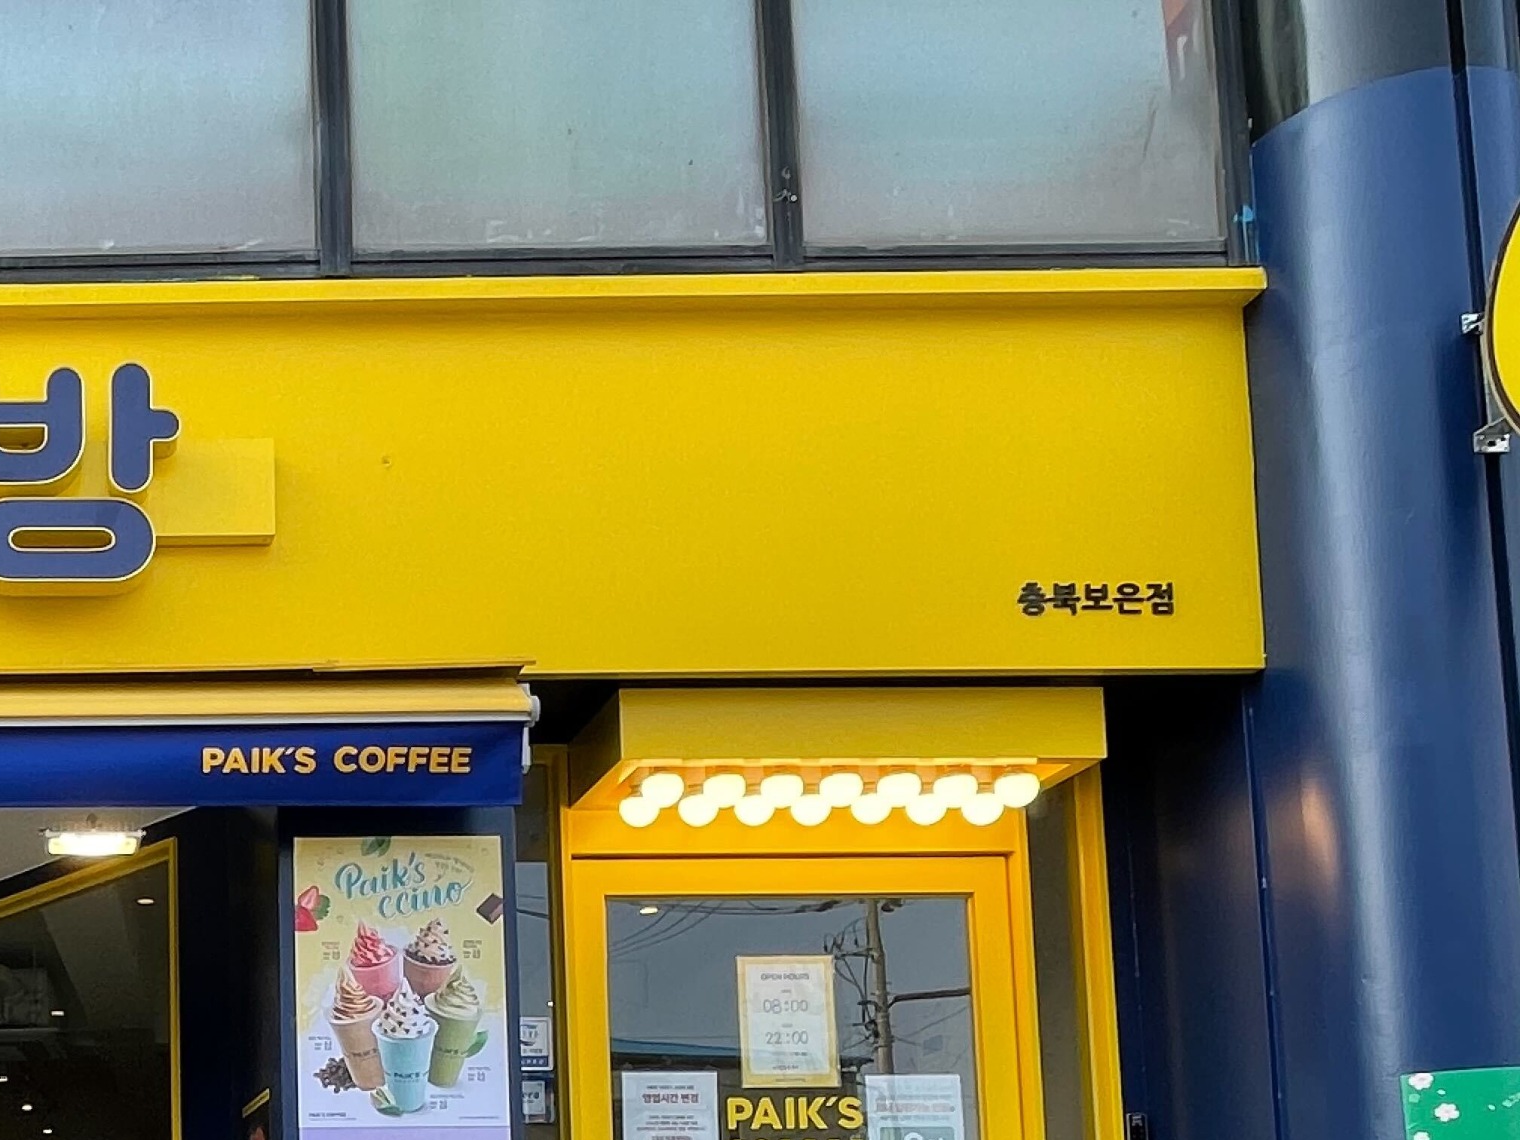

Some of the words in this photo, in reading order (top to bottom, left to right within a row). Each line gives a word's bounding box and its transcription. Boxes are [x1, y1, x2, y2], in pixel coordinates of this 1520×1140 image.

[1017, 582, 1174, 616] 충북보은점
[202, 747, 317, 774] PAIK'S
[334, 746, 472, 773] COFFEE
[334, 852, 426, 899] Paik's
[379, 878, 473, 919] ccino
[727, 1097, 864, 1130] PAIK'S
